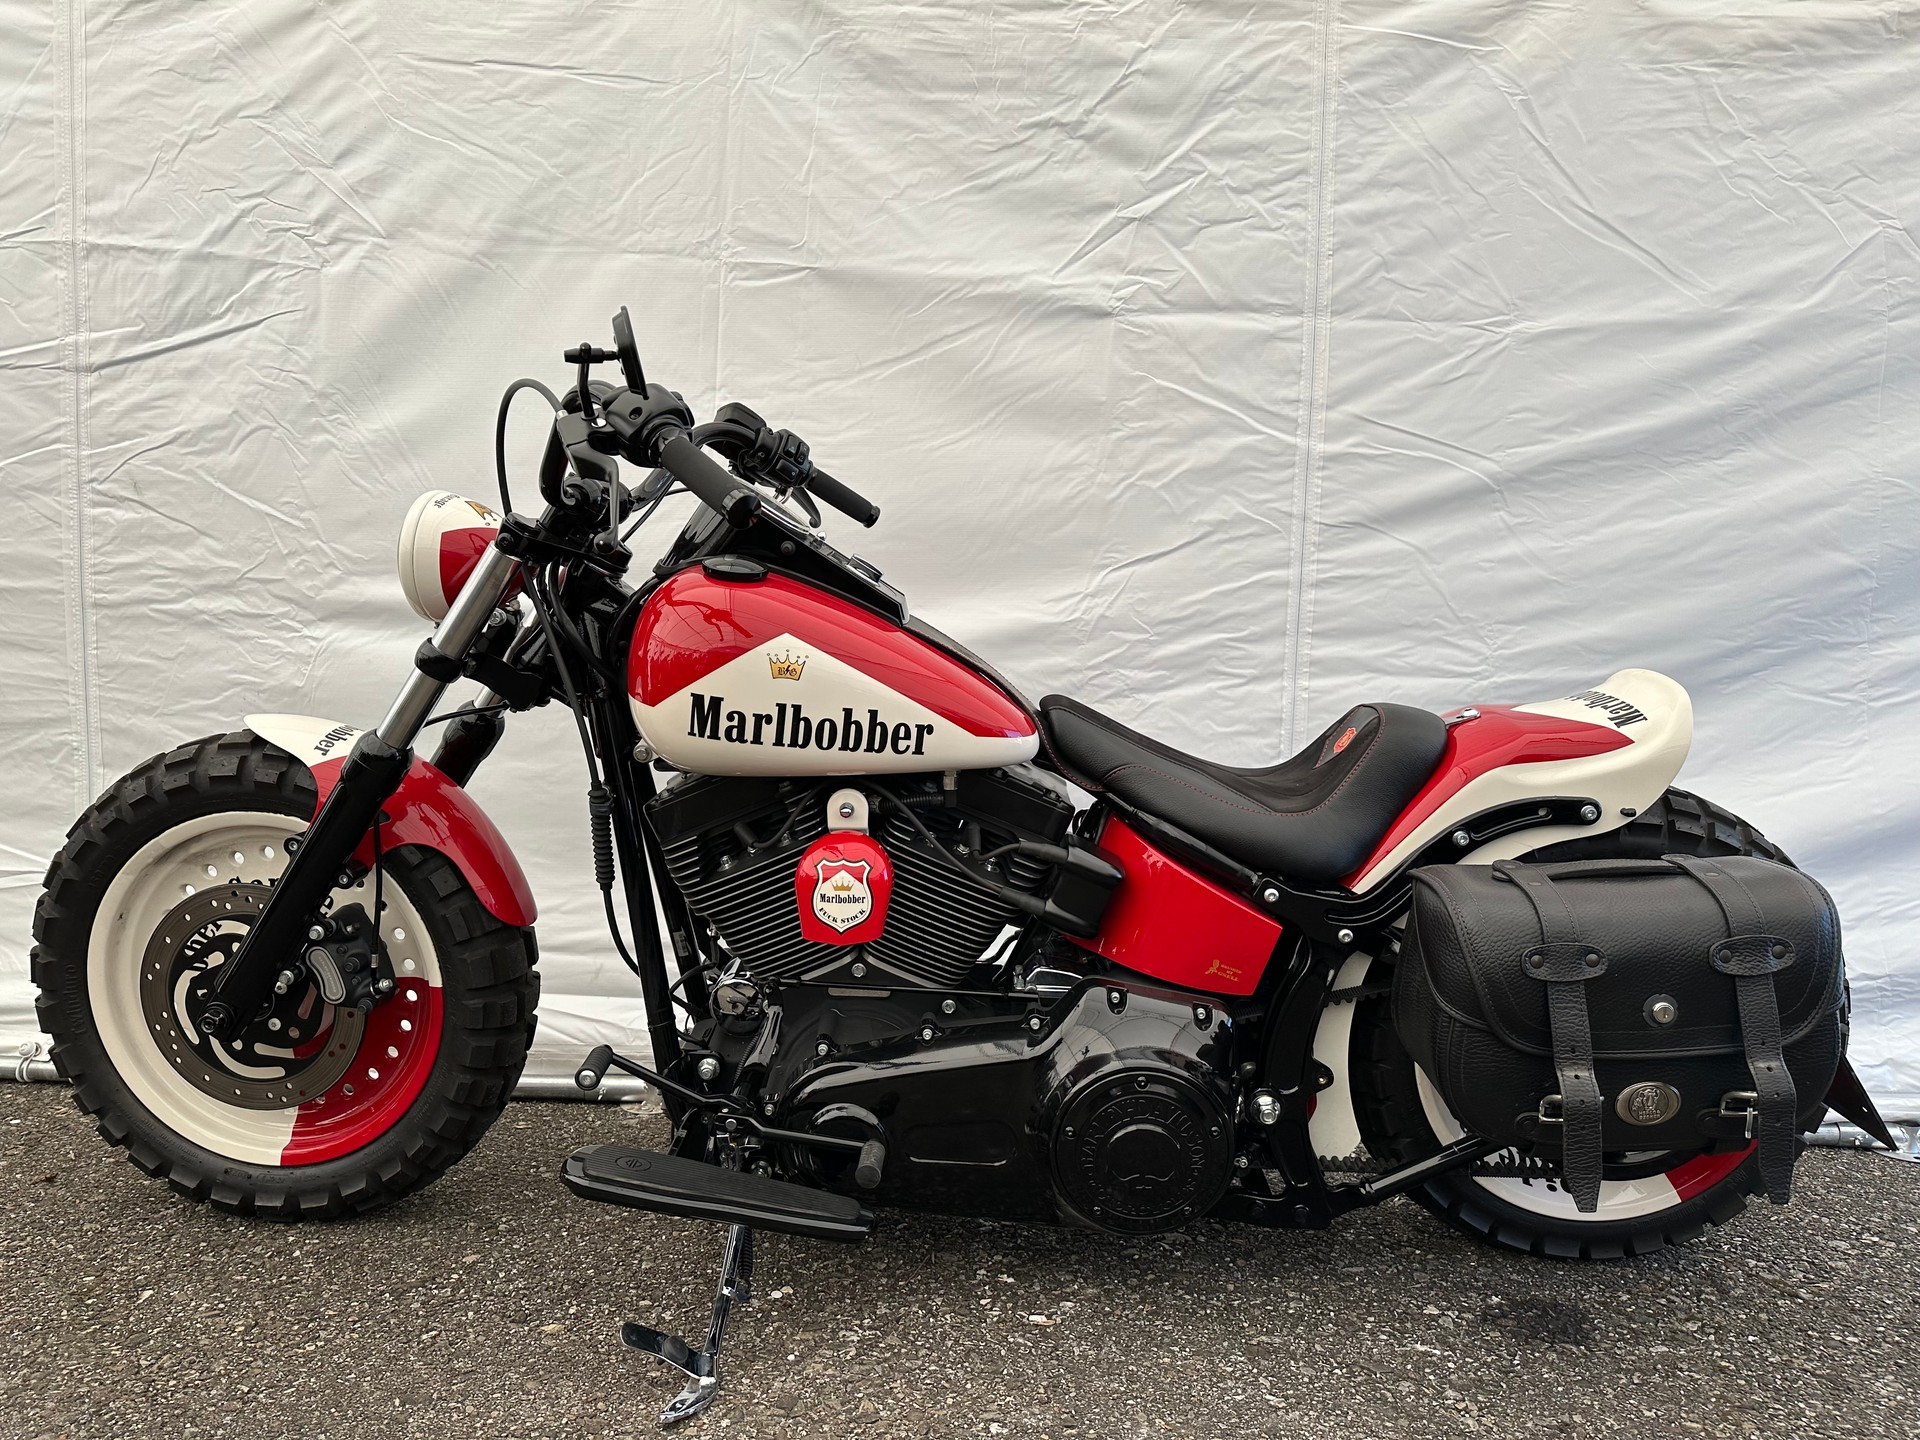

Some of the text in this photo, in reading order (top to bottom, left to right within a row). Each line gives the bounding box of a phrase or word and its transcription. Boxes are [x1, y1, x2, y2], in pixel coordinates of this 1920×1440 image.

[687, 692, 934, 756] Marlbobber
[1564, 690, 1649, 729] Marlbob
[313, 724, 360, 756] obber
[819, 892, 866, 904] Marlbobber
[818, 907, 866, 924] FUCK STOCK
